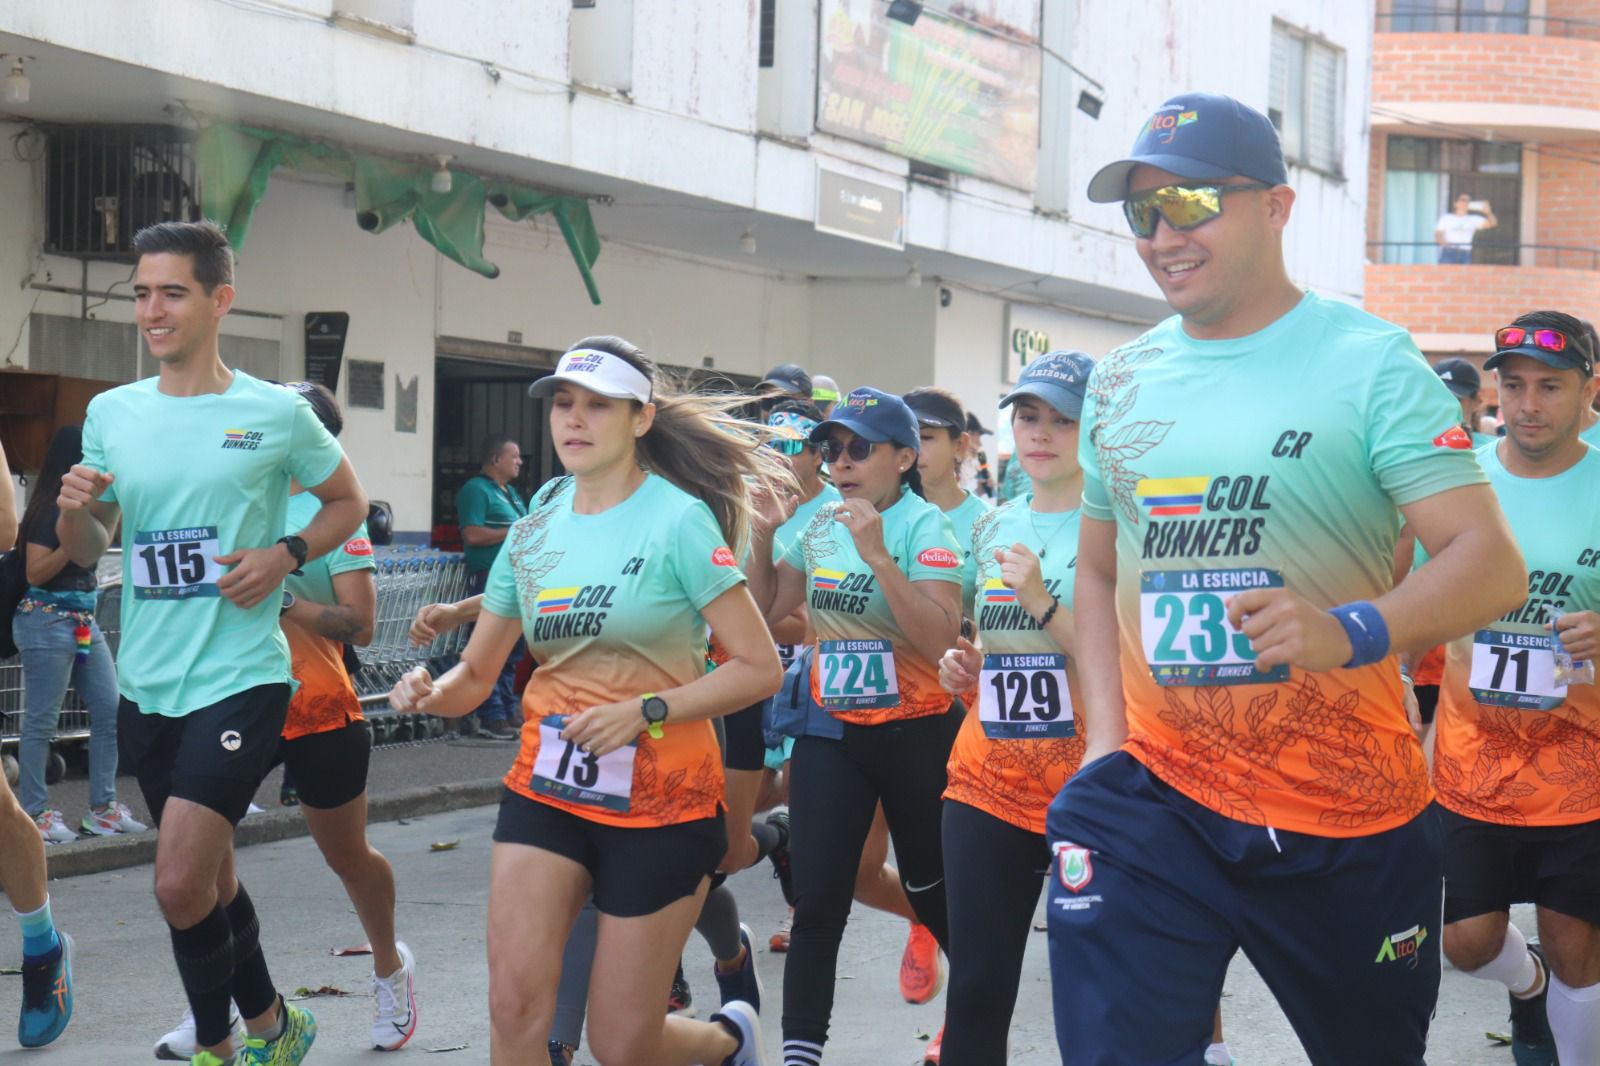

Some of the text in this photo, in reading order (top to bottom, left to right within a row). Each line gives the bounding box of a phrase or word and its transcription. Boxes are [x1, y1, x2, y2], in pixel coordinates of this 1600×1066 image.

[585, 353, 604, 364] COL
[221, 439, 260, 450] RUNNERS
[244, 431, 264, 440] COL
[1272, 430, 1312, 458] CR
[1206, 475, 1271, 511] COL
[152, 528, 209, 541] LA ESENCIA
[1142, 517, 1265, 559] RUNNERS
[139, 542, 205, 586] 115
[621, 557, 645, 575] CR
[839, 572, 876, 593] COL
[1182, 571, 1270, 588] LA ESENCIA
[1528, 570, 1574, 596] COL
[573, 585, 617, 608] COL
[811, 589, 869, 615] RUNNERS
[534, 612, 607, 642] RUNNERS
[836, 641, 884, 651] LA ESENCIA
[1502, 634, 1551, 648] LA ESENC
[1001, 656, 1055, 667] LA ESENCIA
[1216, 665, 1253, 677] RUNNERS
[1490, 646, 1530, 692] 71
[824, 654, 888, 695] 224
[991, 671, 1061, 721] 129
